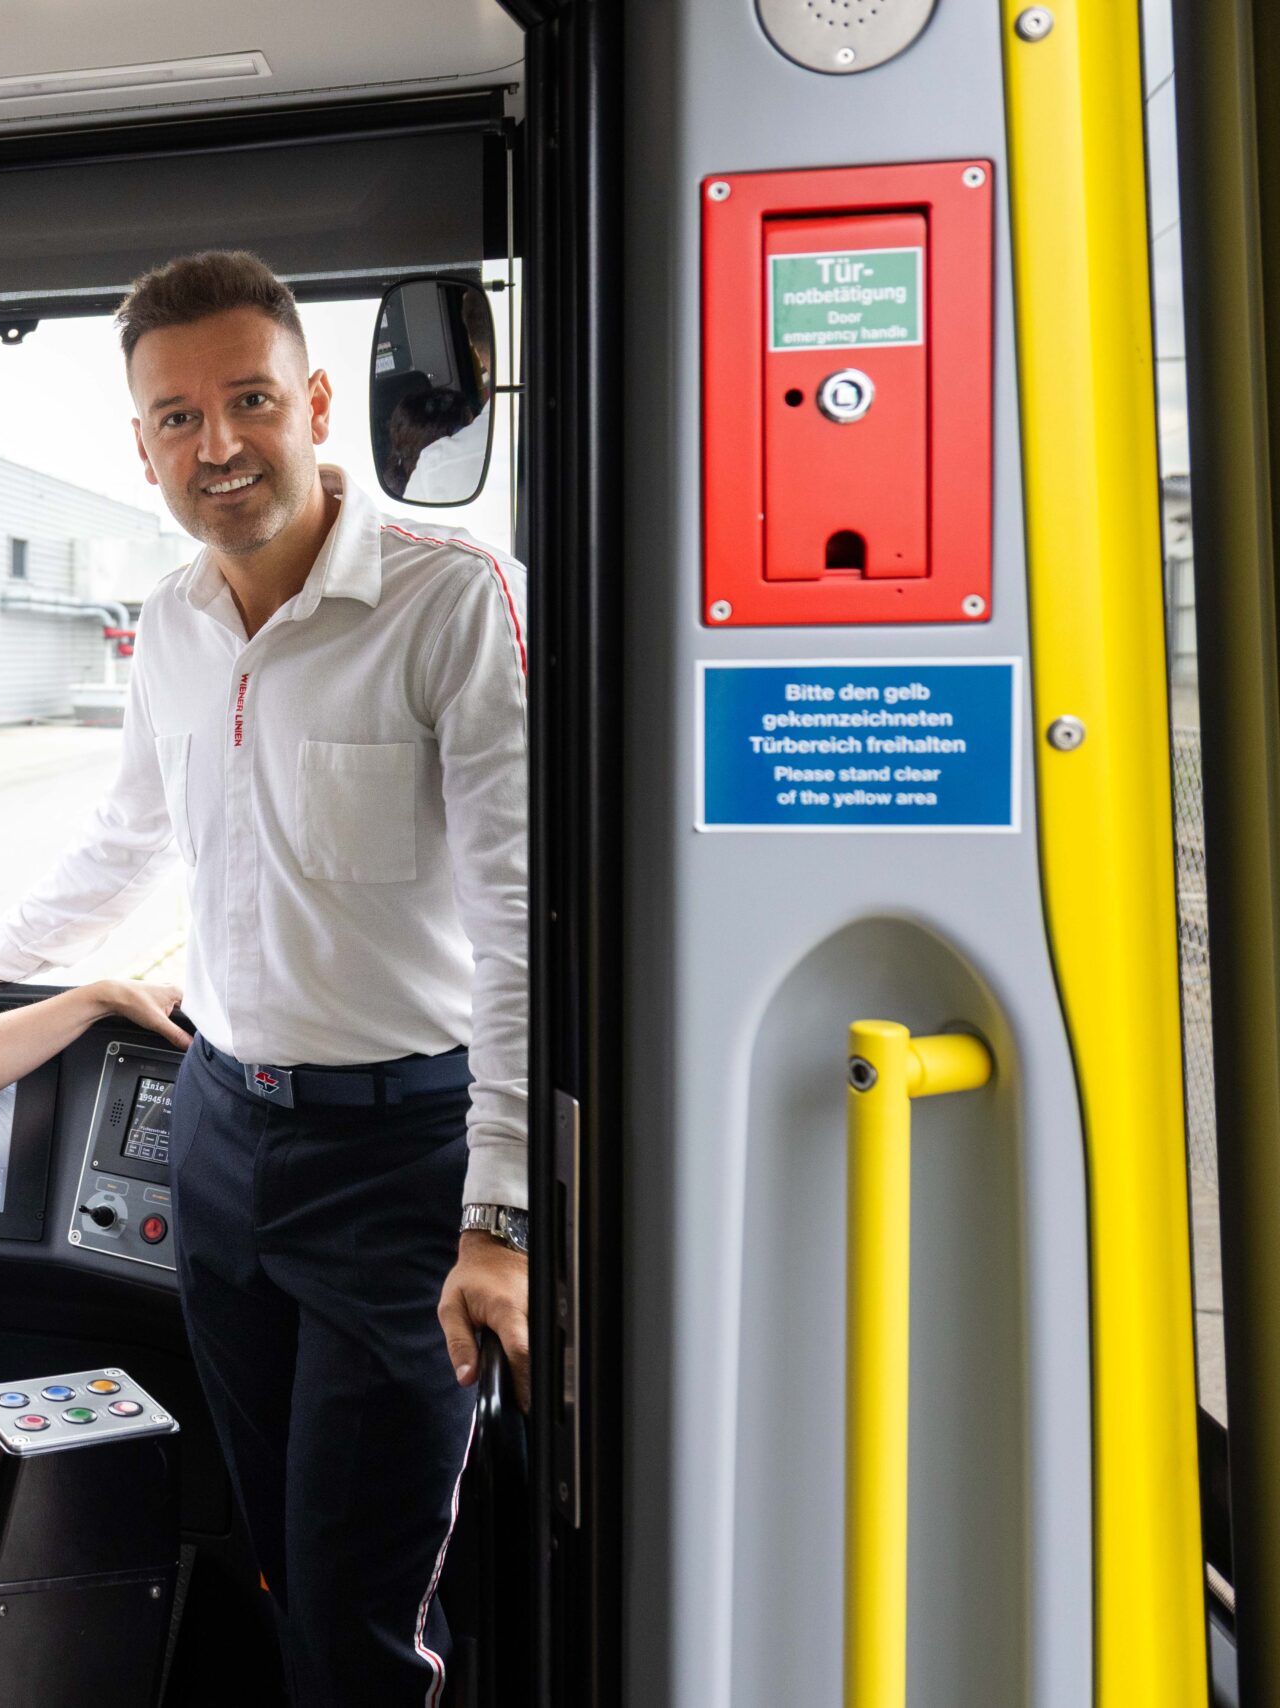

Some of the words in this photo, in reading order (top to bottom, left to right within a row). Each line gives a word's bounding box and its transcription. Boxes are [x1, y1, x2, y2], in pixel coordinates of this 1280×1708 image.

[816, 257, 874, 284] Tür-
[783, 284, 908, 306] notbetätigung
[827, 311, 863, 325] Door
[782, 329, 858, 345] emergency
[860, 325, 909, 340] handle
[236, 673, 249, 712] WIENER
[785, 684, 835, 701] Bitte
[838, 684, 880, 701] den
[883, 683, 931, 704] gelb
[762, 709, 954, 731] gekennzeichneten
[234, 714, 244, 747] LINIEN
[749, 735, 863, 754] Türbereich
[865, 735, 967, 754] freihalten
[774, 766, 836, 783] Please
[838, 766, 891, 782] stand
[893, 766, 942, 782] clear
[776, 790, 797, 806] of
[799, 790, 830, 806] the
[832, 789, 893, 809] yellow
[895, 793, 938, 806] area
[141, 1081, 165, 1092] Linie
[139, 1093, 172, 1106] 19945!8
